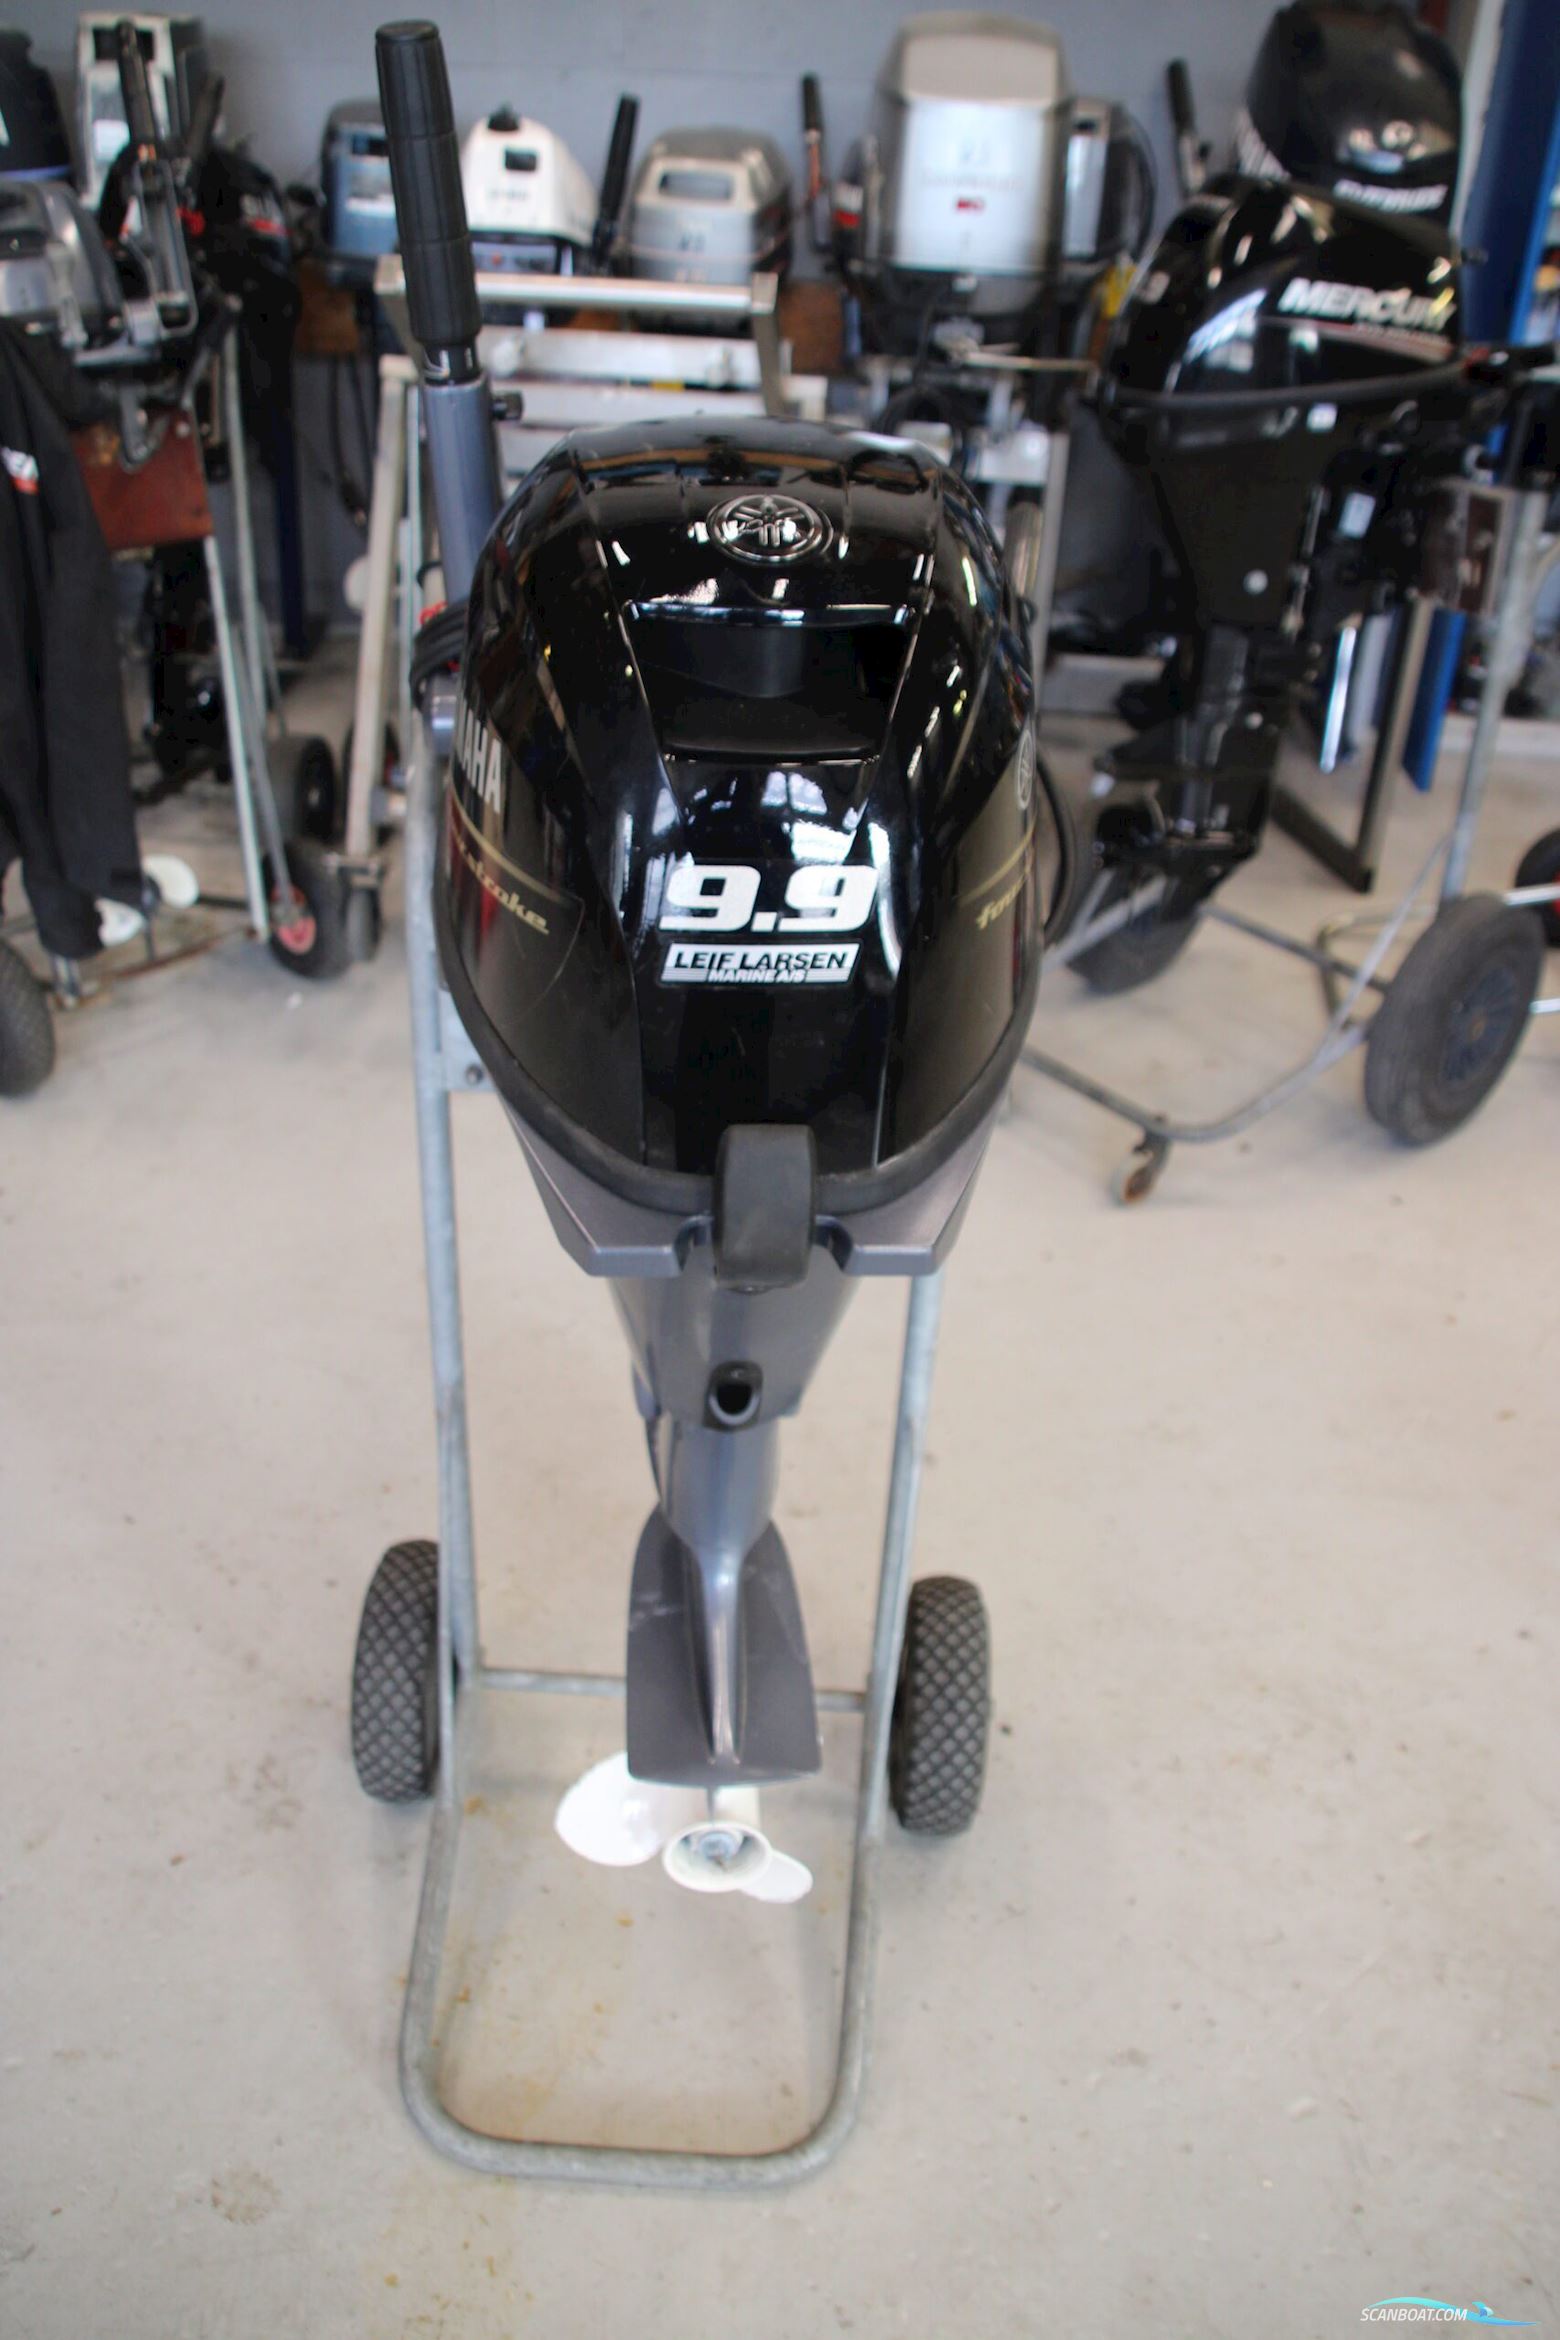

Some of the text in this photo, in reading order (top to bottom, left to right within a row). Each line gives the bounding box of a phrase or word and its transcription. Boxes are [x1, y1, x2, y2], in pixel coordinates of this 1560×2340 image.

[1277, 277, 1457, 332] MERCURY
[658, 865, 879, 932] 9.9
[674, 952, 847, 970] LEIF LARSEN
[707, 969, 806, 983] MARINE A/S
